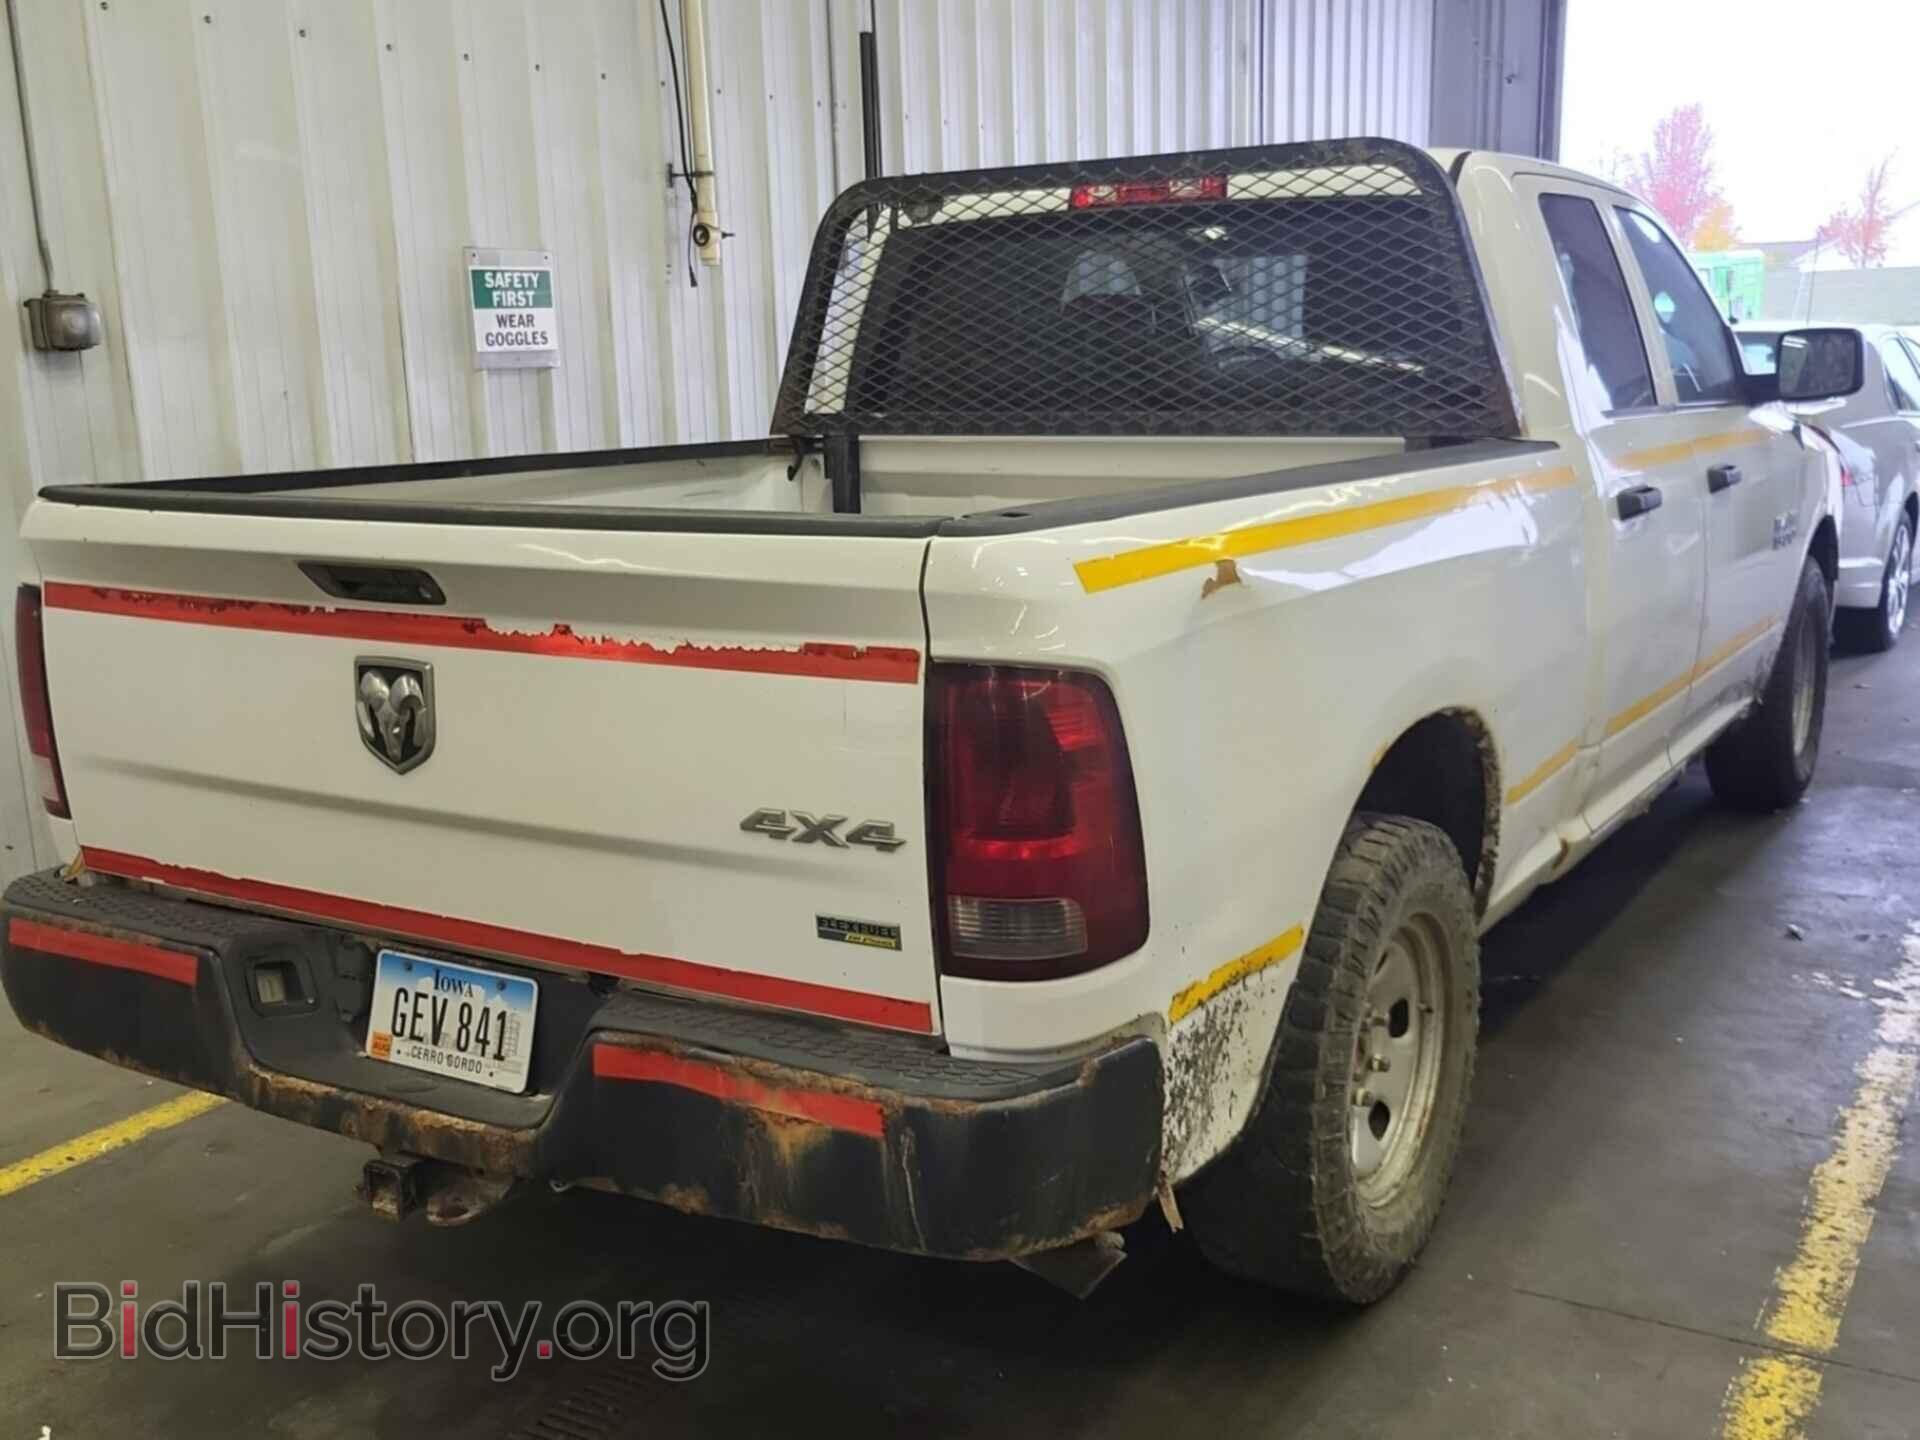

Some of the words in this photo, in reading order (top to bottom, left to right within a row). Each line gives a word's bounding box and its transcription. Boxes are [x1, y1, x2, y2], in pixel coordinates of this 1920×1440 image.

[484, 272, 539, 289] SAFETY
[492, 290, 535, 307] FIRST
[496, 314, 535, 328] WEAR
[485, 331, 549, 346] GOGGLES
[739, 806, 907, 853] 4X4
[391, 987, 448, 1046] GEV
[456, 1002, 507, 1061] 841
[410, 1045, 444, 1064] CERRO
[446, 1054, 482, 1074] GORDO
